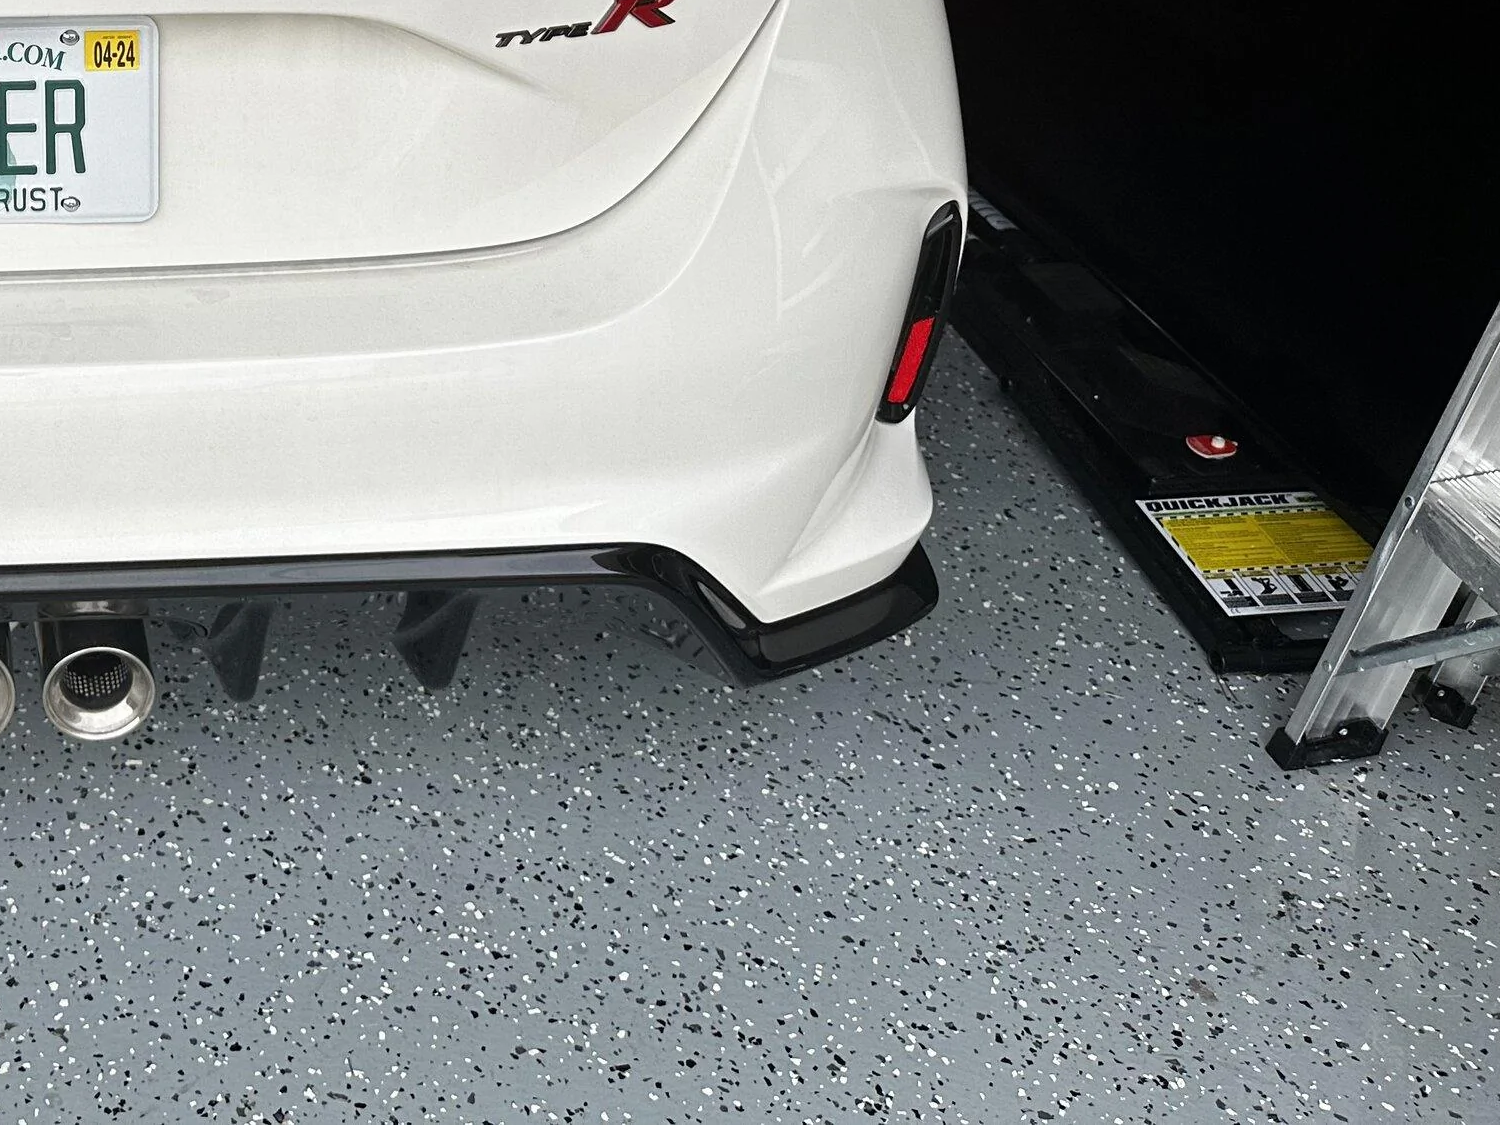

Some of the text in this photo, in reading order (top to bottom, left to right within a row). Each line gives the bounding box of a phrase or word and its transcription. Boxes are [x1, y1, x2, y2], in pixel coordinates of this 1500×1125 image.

[494, 21, 592, 48] TYPE
[93, 40, 136, 68] 04-24
[1145, 492, 1288, 513] QUICKJACK
